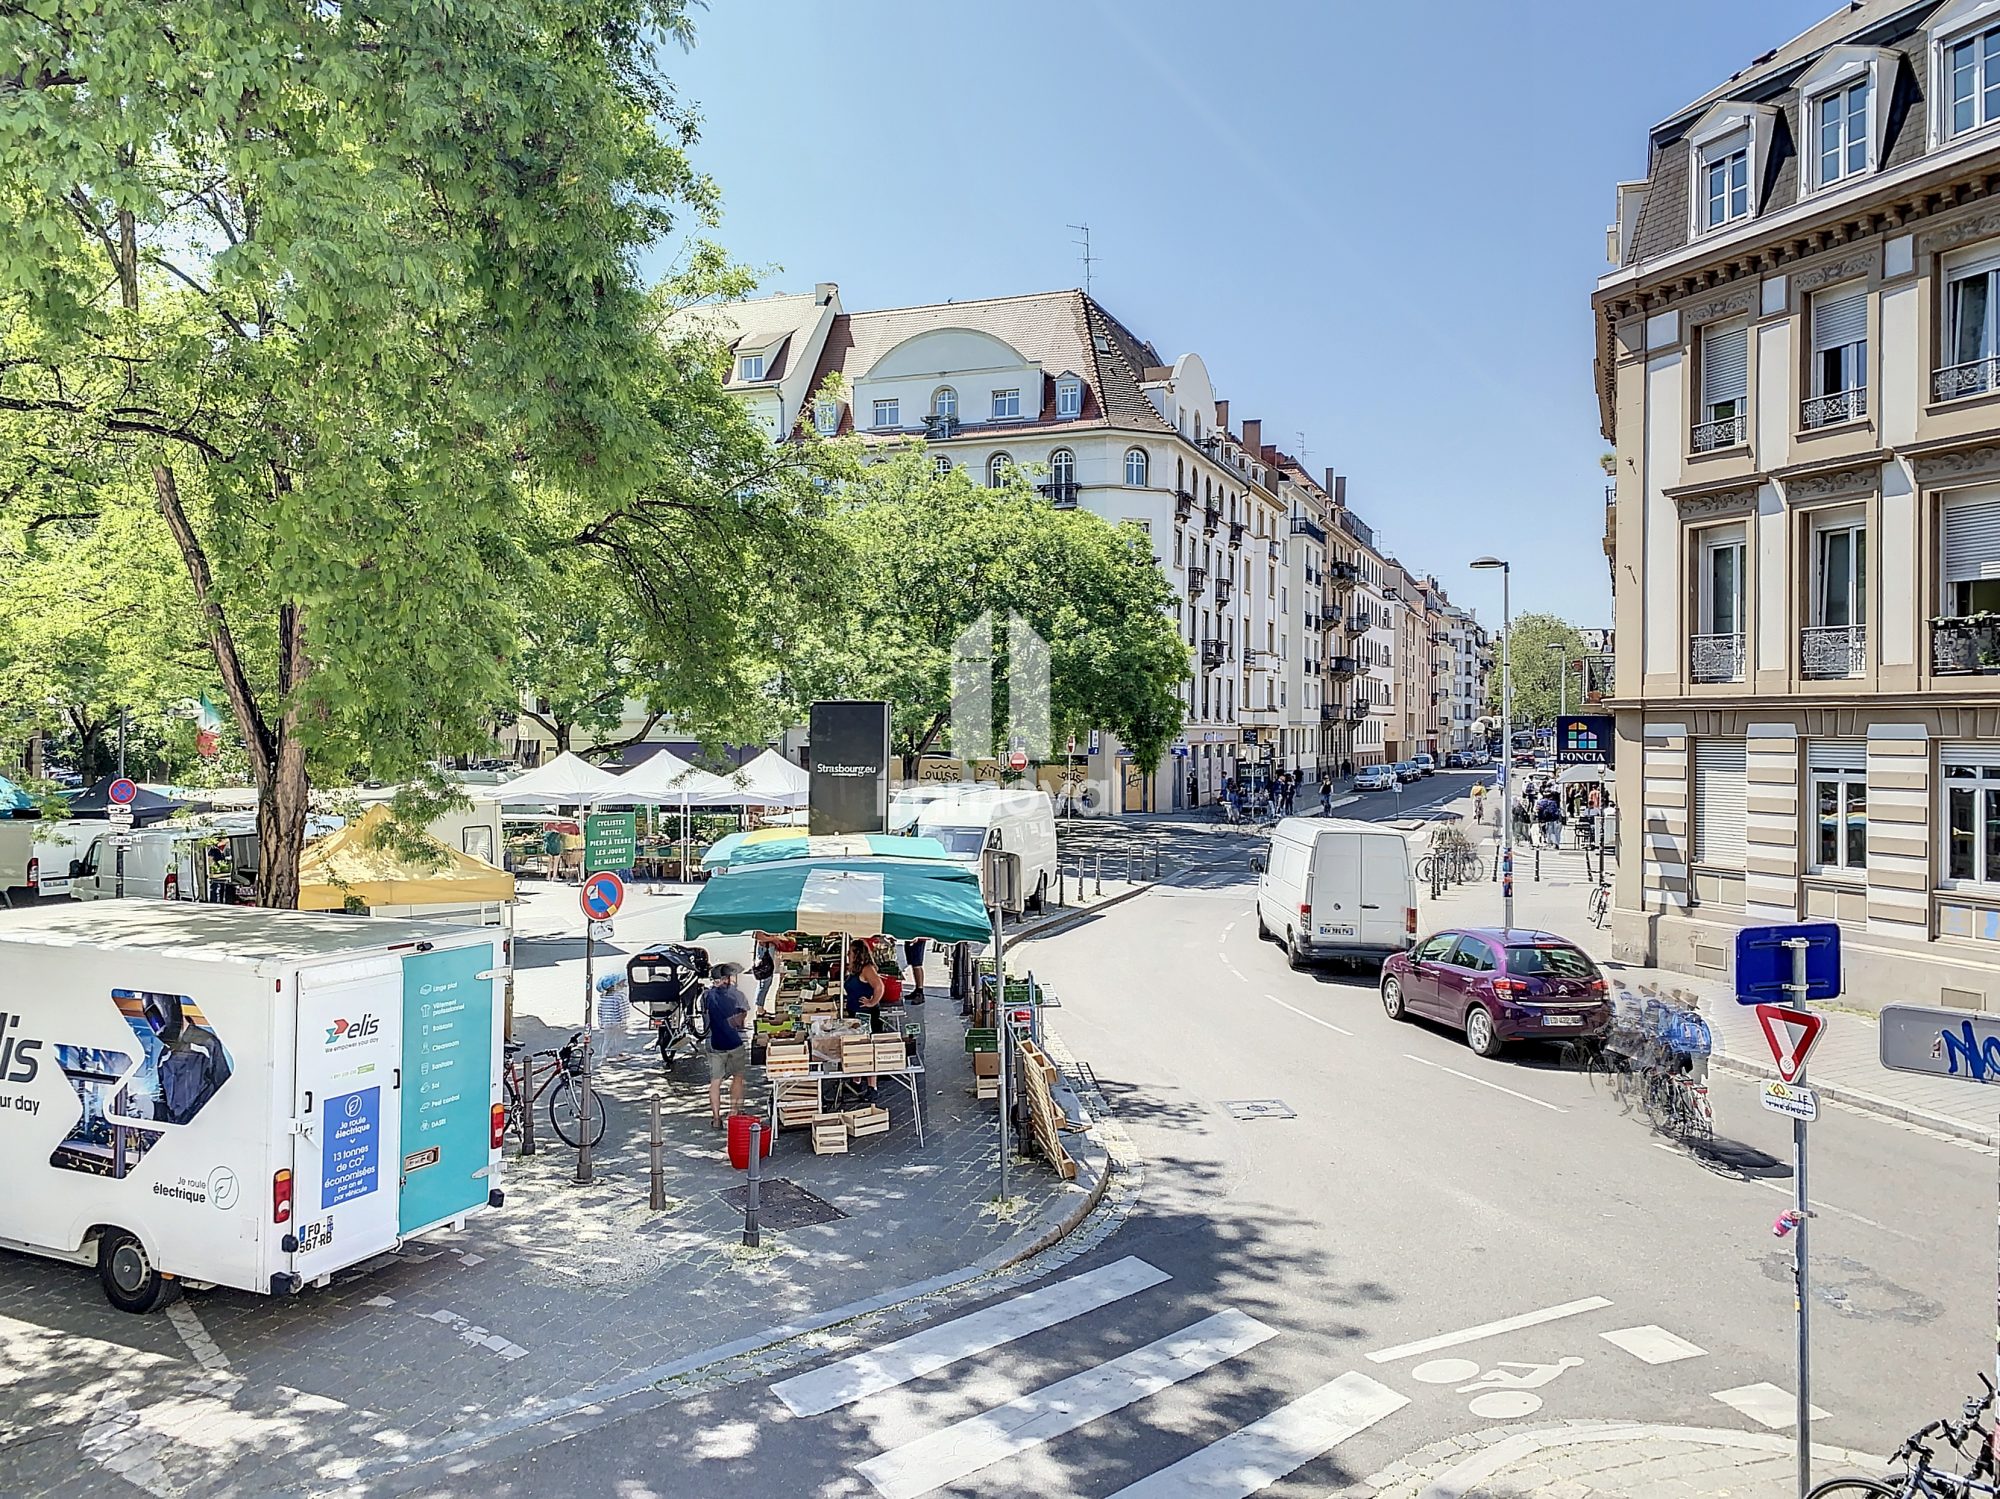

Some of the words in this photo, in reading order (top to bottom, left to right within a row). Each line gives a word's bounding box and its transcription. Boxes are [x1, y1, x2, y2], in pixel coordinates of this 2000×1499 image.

[1560, 752, 1606, 762] FONCIA
[817, 763, 876, 777] Strasbourg.eu
[590, 839, 607, 847] PIEDS
[608, 837, 613, 845] À
[614, 837, 632, 845] TERRE
[607, 847, 626, 855] JOURS
[603, 856, 627, 865] MARCHÉ
[347, 1013, 380, 1039] elis
[15, 1095, 40, 1116] day
[340, 1121, 348, 1130] Je
[348, 1116, 367, 1127] roule
[335, 1123, 371, 1139] électrique
[333, 1152, 342, 1162] 13
[343, 1145, 369, 1159] tonnes
[336, 1163, 347, 1173] de
[177, 1176, 186, 1186] Je
[187, 1179, 206, 1190] roule
[324, 1166, 376, 1188] économisées
[152, 1181, 206, 1204] électrique
[337, 1184, 348, 1193] par
[357, 1178, 363, 1186] et
[333, 1194, 344, 1203] par
[344, 1185, 368, 1199] véhicule
